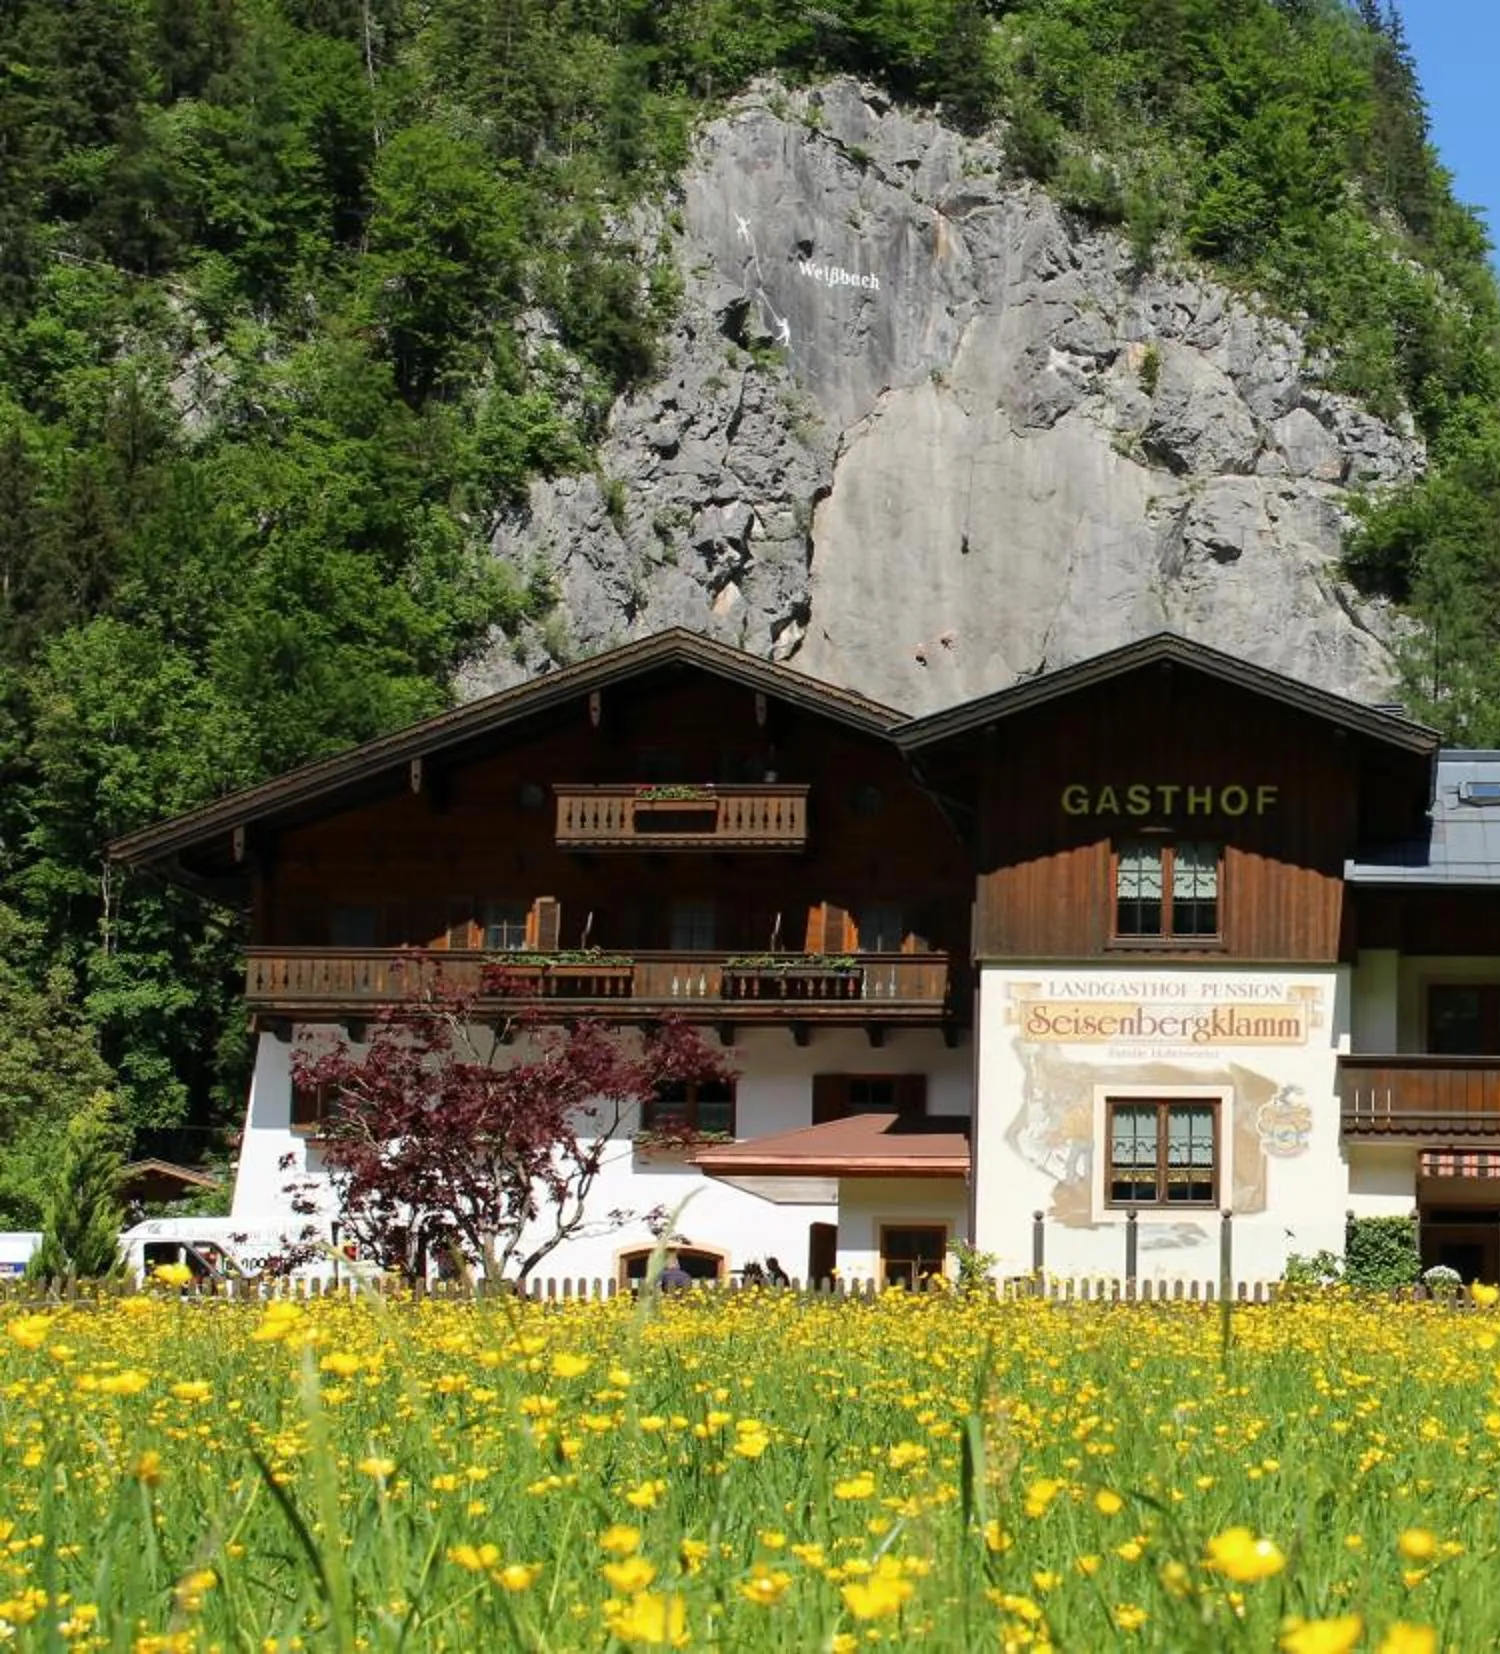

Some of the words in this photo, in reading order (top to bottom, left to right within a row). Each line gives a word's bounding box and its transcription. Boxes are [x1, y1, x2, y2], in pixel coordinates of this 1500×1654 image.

[1061, 784, 1279, 816] GASTHOF
[1049, 981, 1186, 998] LANDGASTHOF
[1202, 983, 1282, 998] PENSION
[1027, 1006, 1300, 1043] Seisenbergklamm
